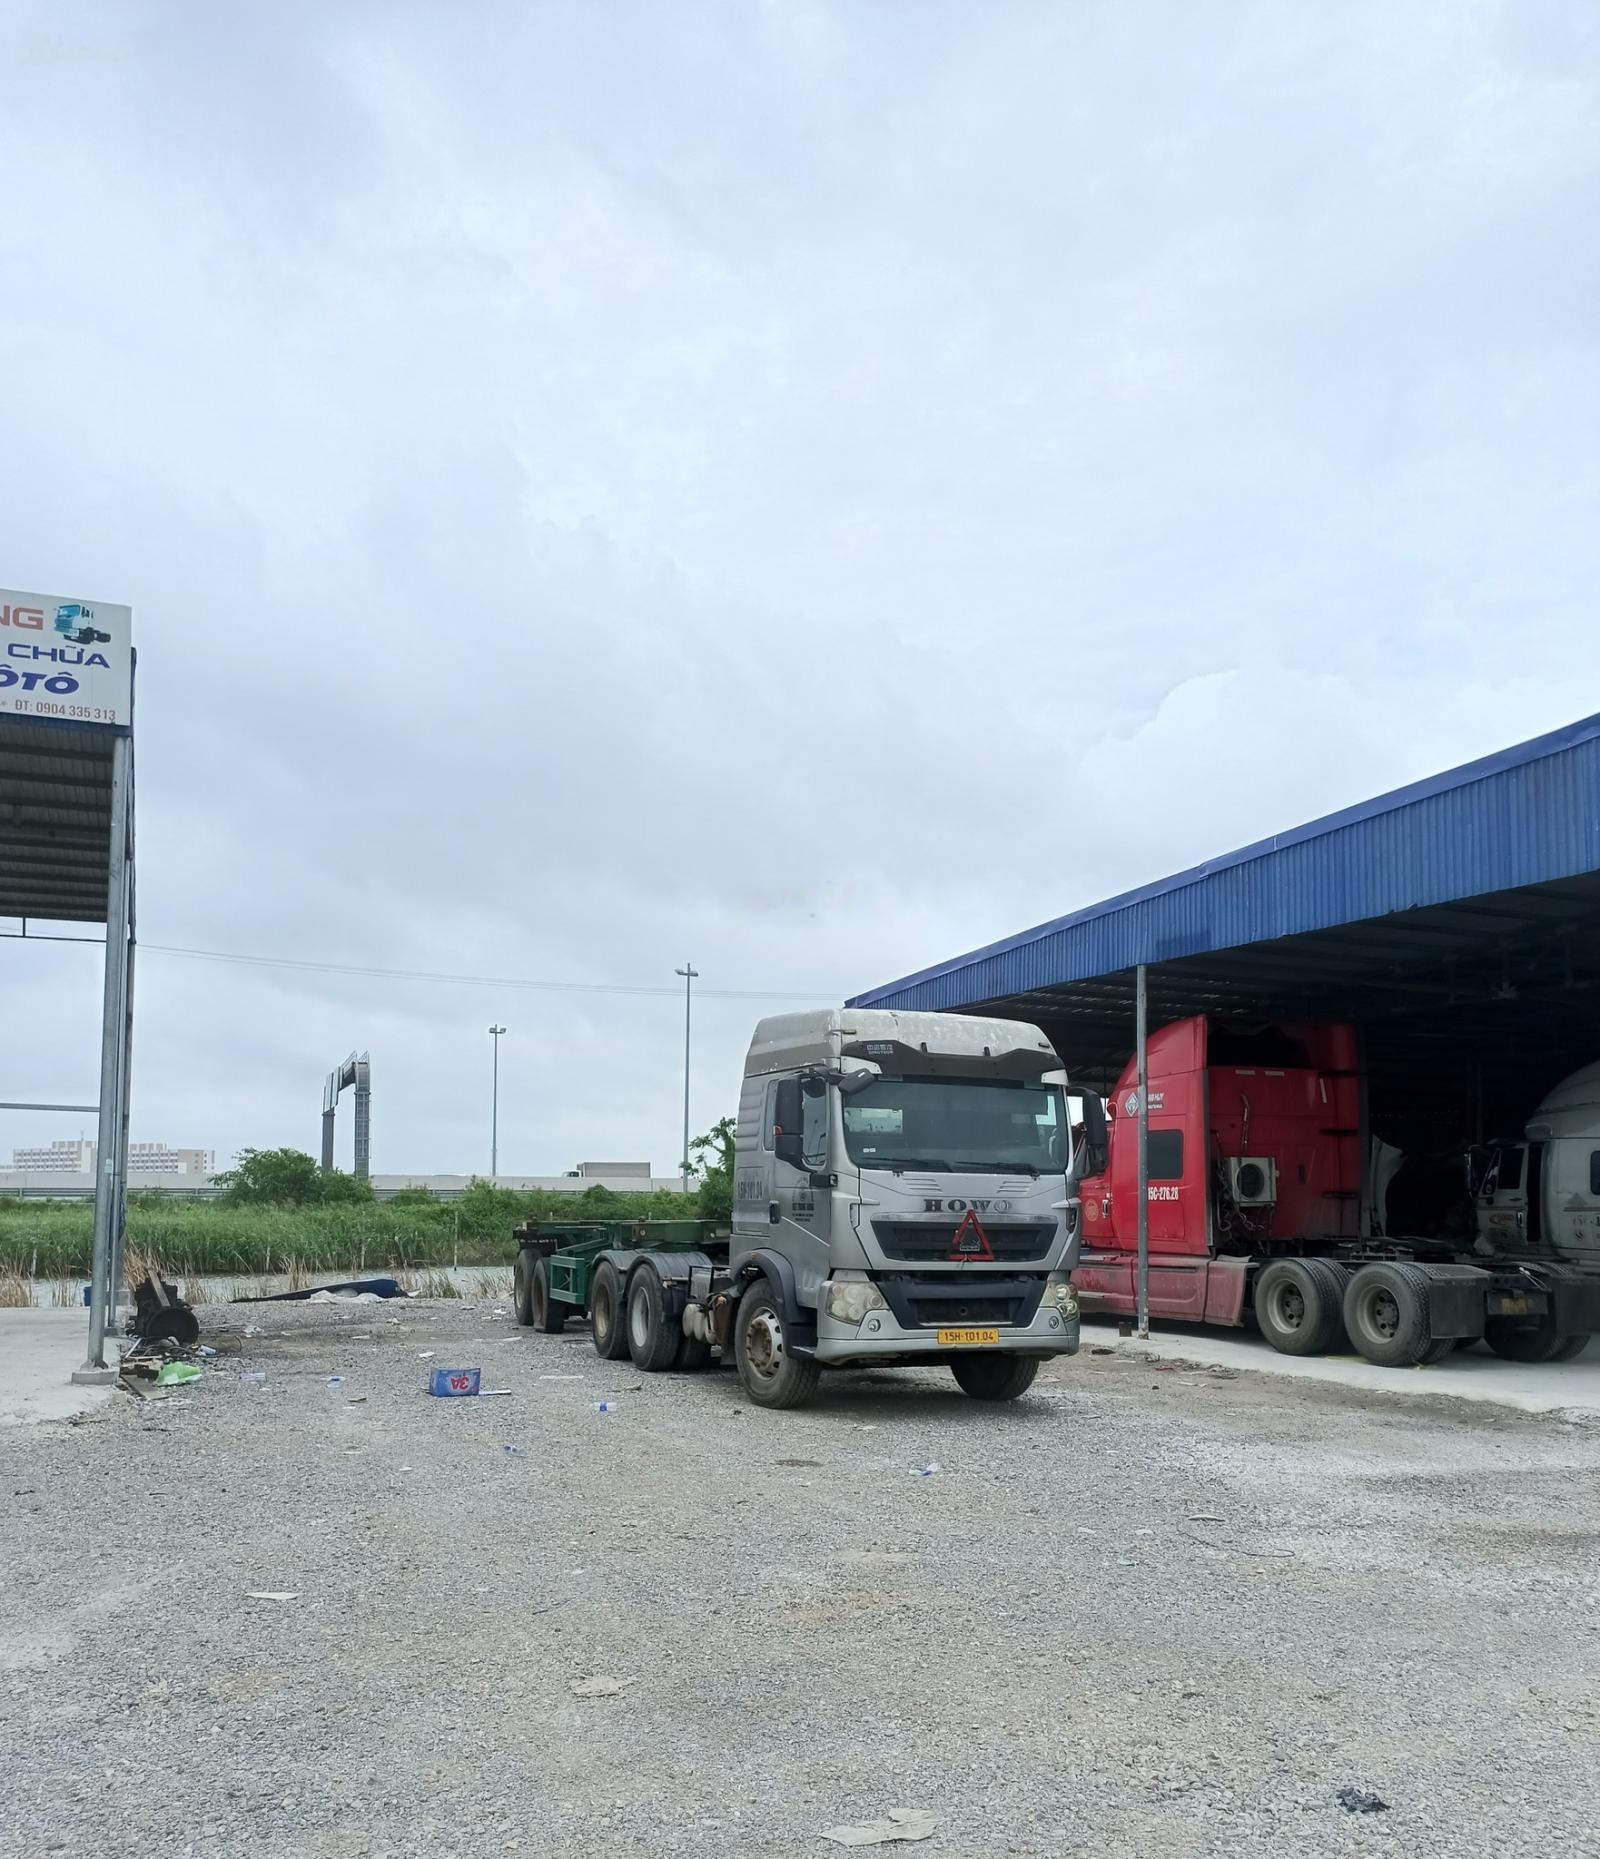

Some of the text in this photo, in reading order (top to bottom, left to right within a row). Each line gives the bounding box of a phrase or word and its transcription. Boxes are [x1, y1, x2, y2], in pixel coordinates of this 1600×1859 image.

[8, 643, 111, 669] CHỮA
[36, 702, 66, 716] 0904
[69, 705, 91, 719] 335
[94, 708, 116, 721] 313
[924, 1199, 1012, 1214] HOWO
[944, 1331, 994, 1342] 15H-101.04
